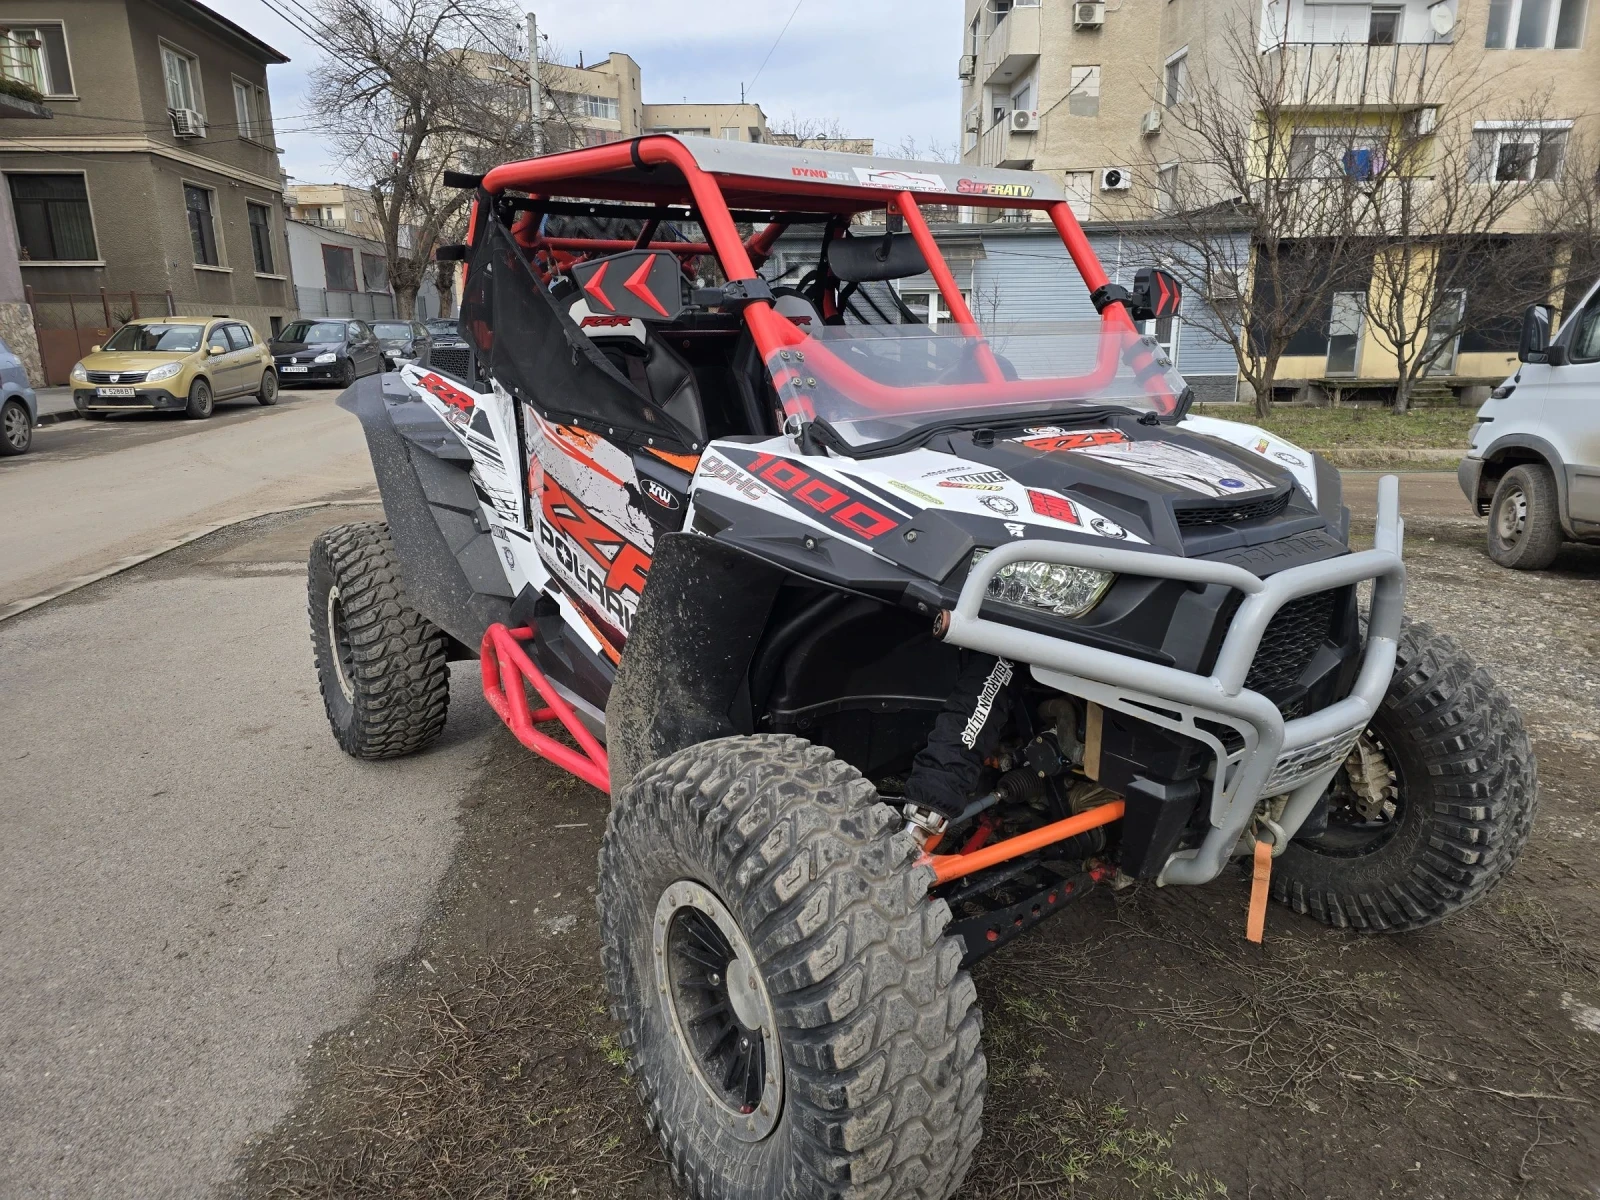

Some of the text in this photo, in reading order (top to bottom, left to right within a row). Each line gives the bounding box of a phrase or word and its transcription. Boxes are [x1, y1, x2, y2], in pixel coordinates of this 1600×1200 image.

[581, 315, 633, 328] RZR
[701, 455, 768, 500] DOHC
[746, 451, 899, 540] 1000
[539, 517, 637, 632] POLARI
